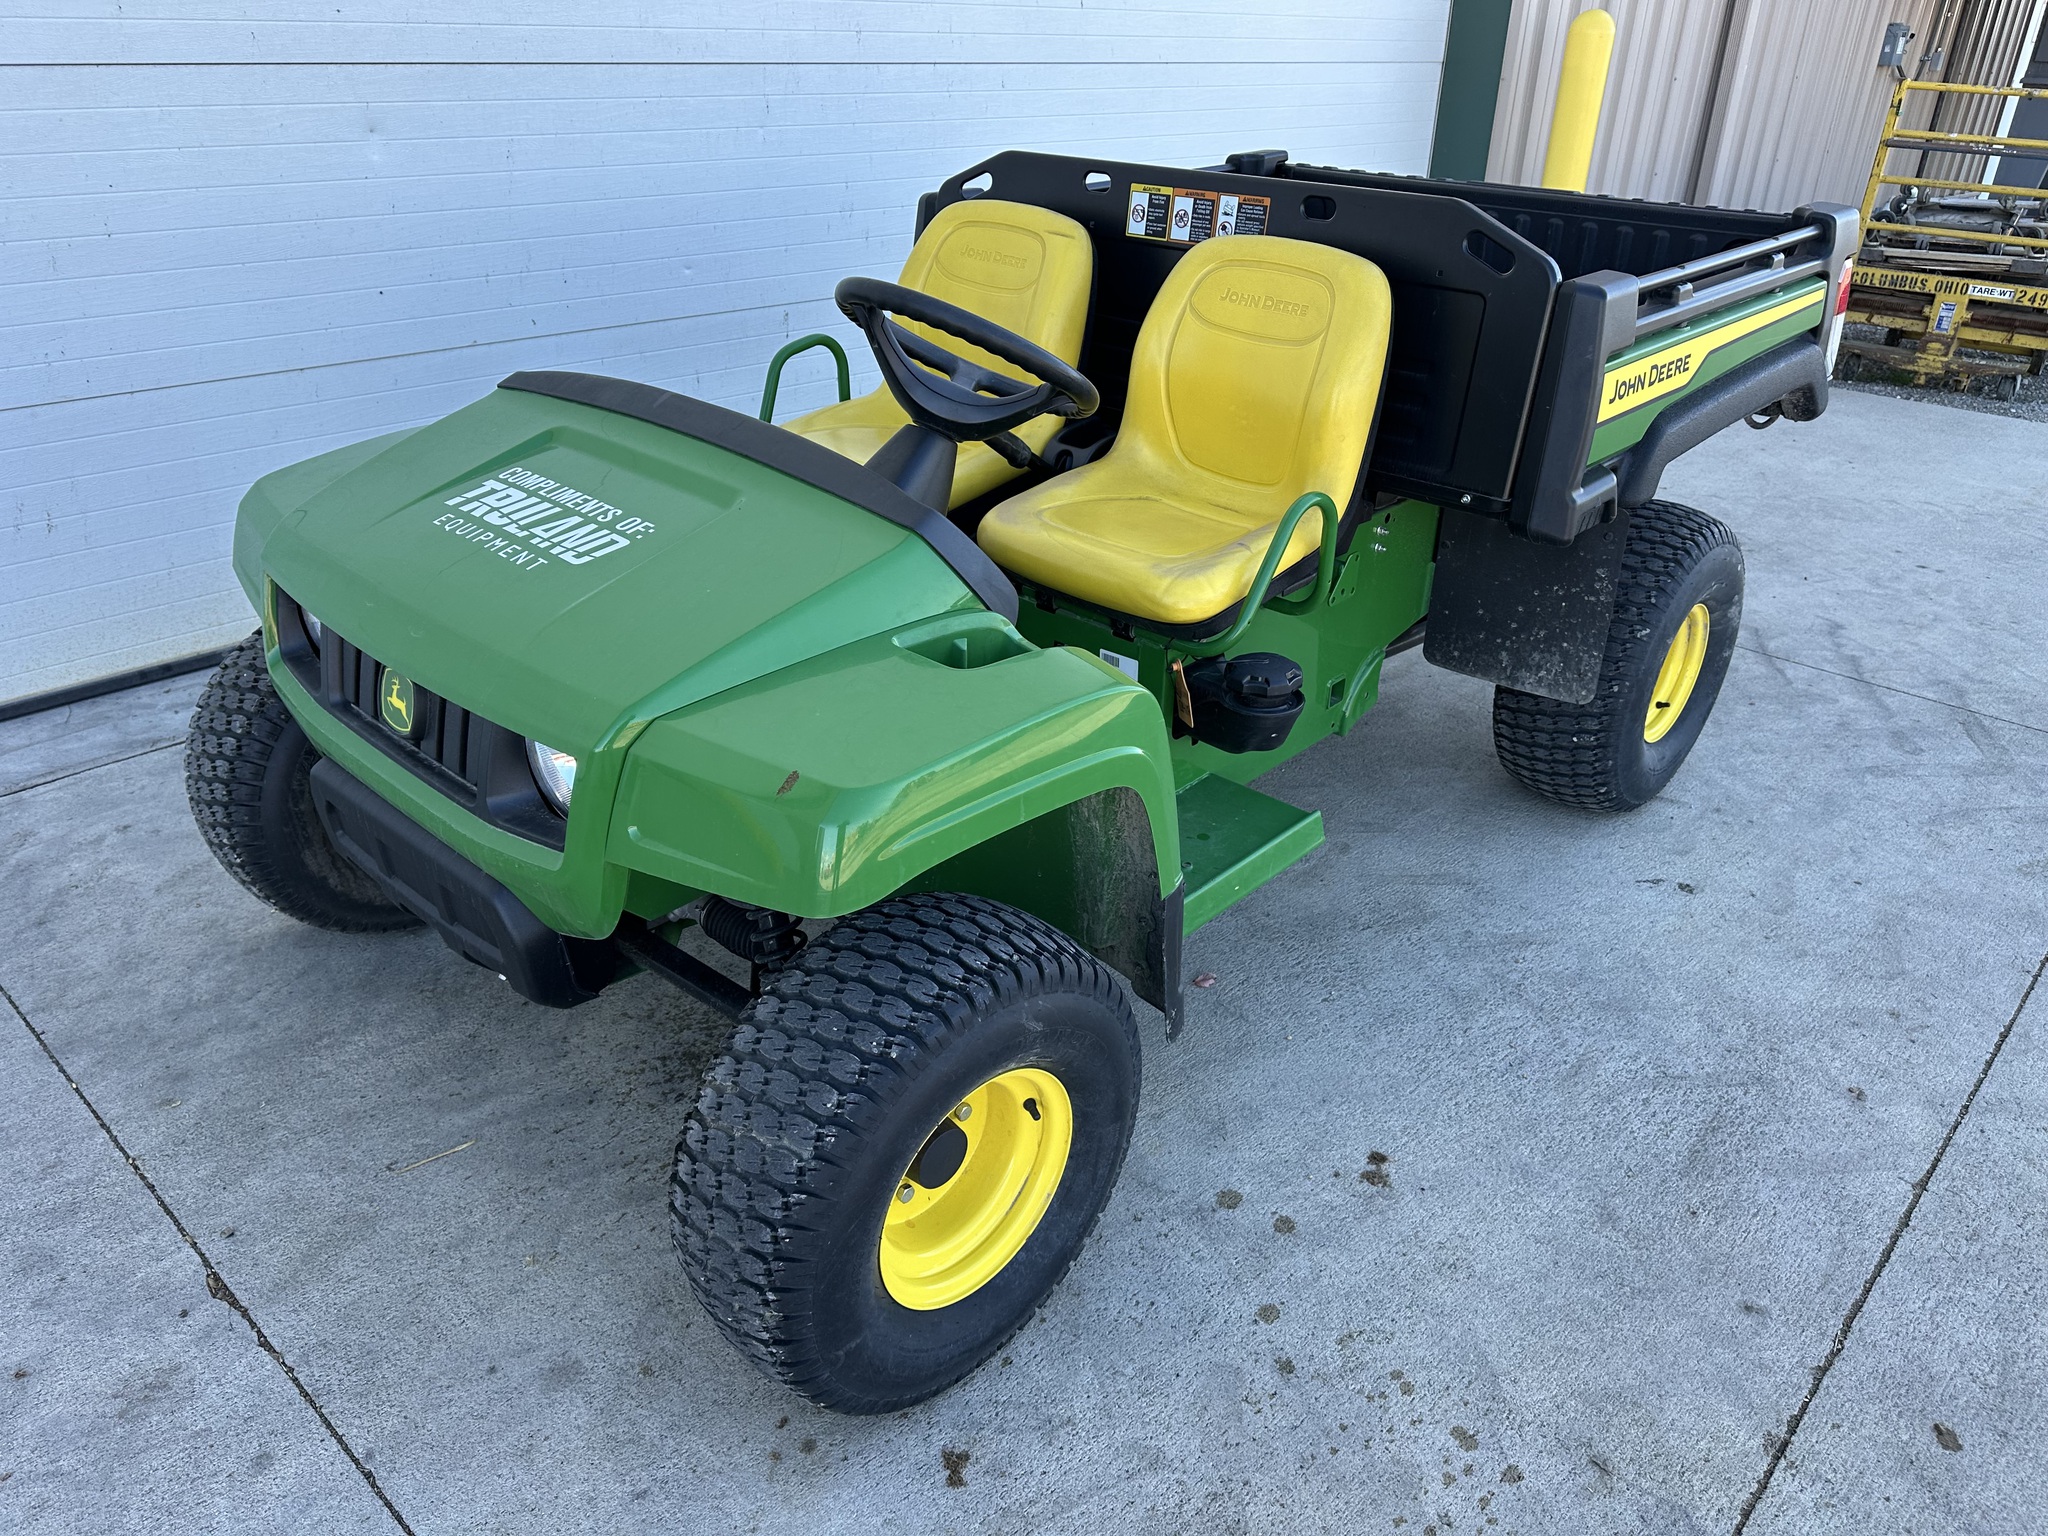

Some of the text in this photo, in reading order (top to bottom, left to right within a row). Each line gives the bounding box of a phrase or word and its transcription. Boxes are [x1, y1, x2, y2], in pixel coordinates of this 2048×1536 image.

[959, 244, 1028, 269] JOHN DEERE
[1219, 287, 1310, 317] JOHN DEERE
[1934, 279, 1970, 296] OHIO
[1608, 353, 1692, 405] JOHN DEERE
[498, 467, 623, 522] COMPLIMENTS
[432, 513, 549, 571] EQUIPMENT
[444, 479, 631, 565] TRULAND
